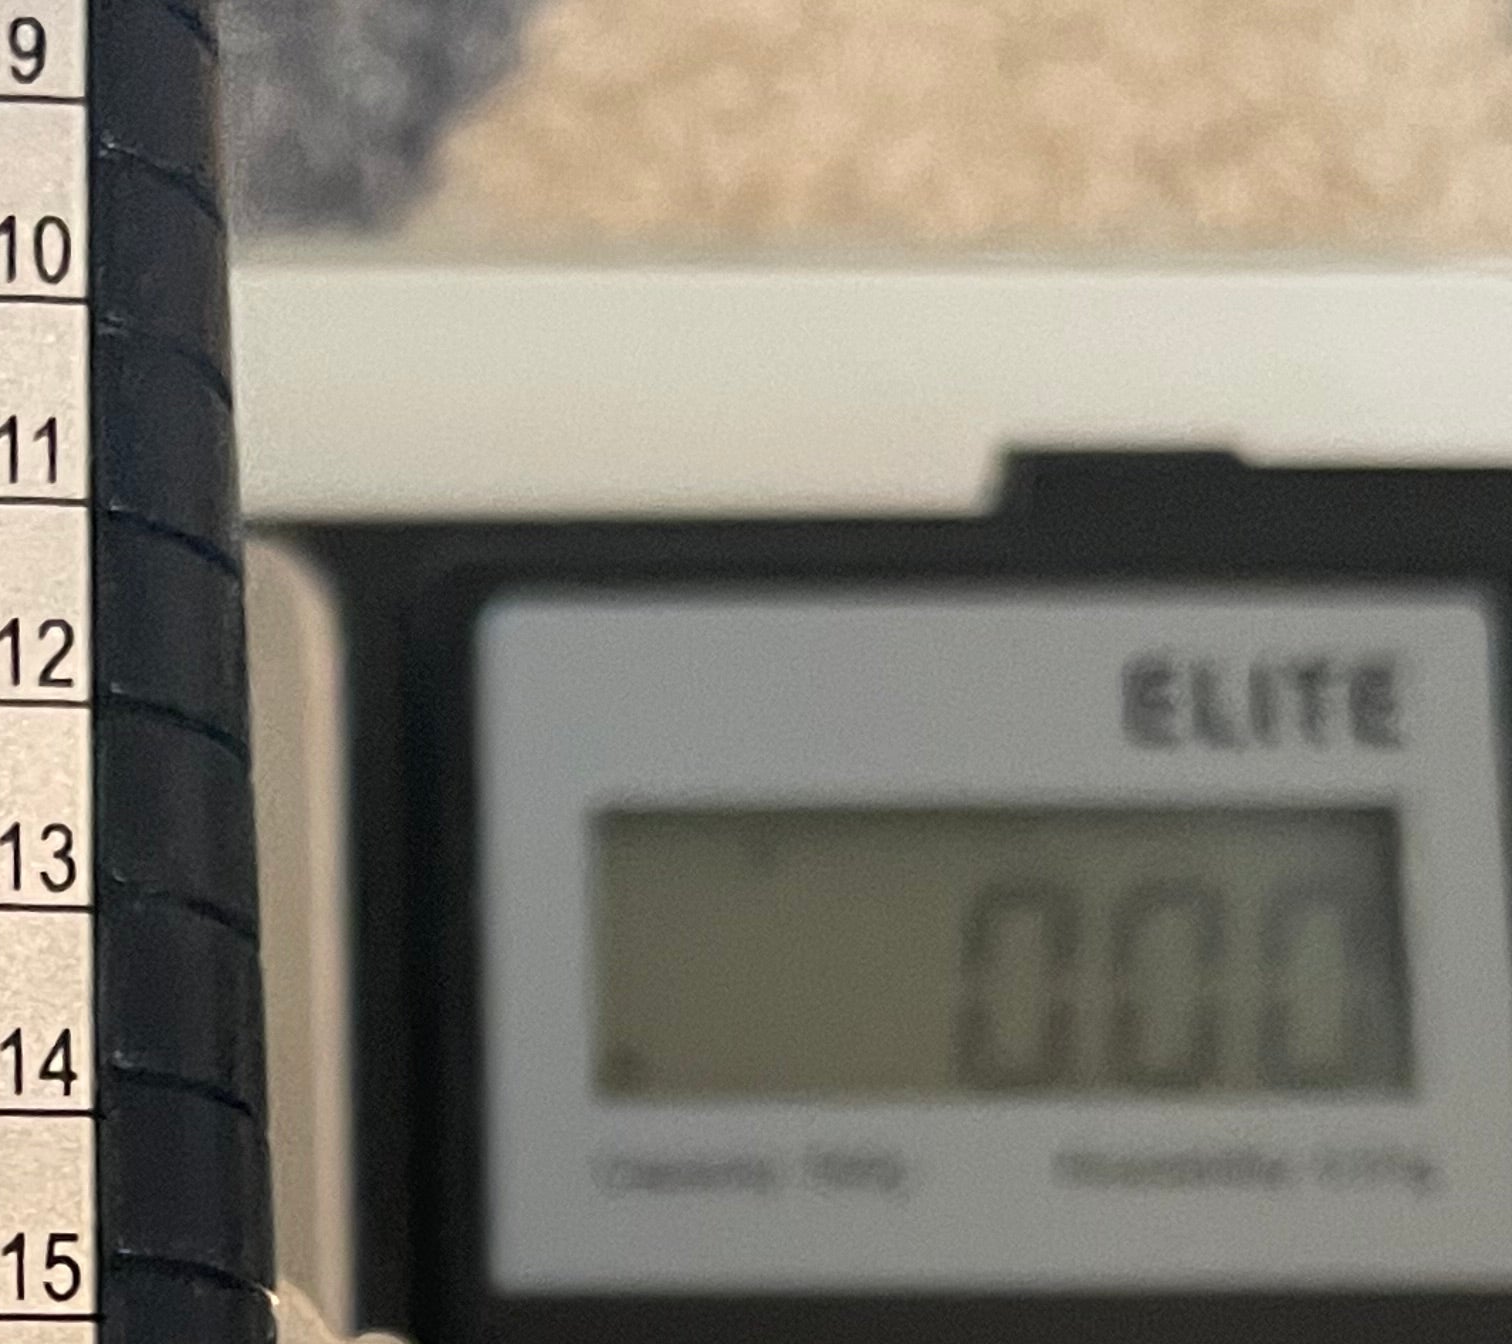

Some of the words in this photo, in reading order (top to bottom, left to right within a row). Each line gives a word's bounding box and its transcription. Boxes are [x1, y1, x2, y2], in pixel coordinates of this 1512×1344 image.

[7, 15, 48, 85] 9
[1118, 650, 1404, 752] ELITE
[0, 1231, 83, 1304] 15
